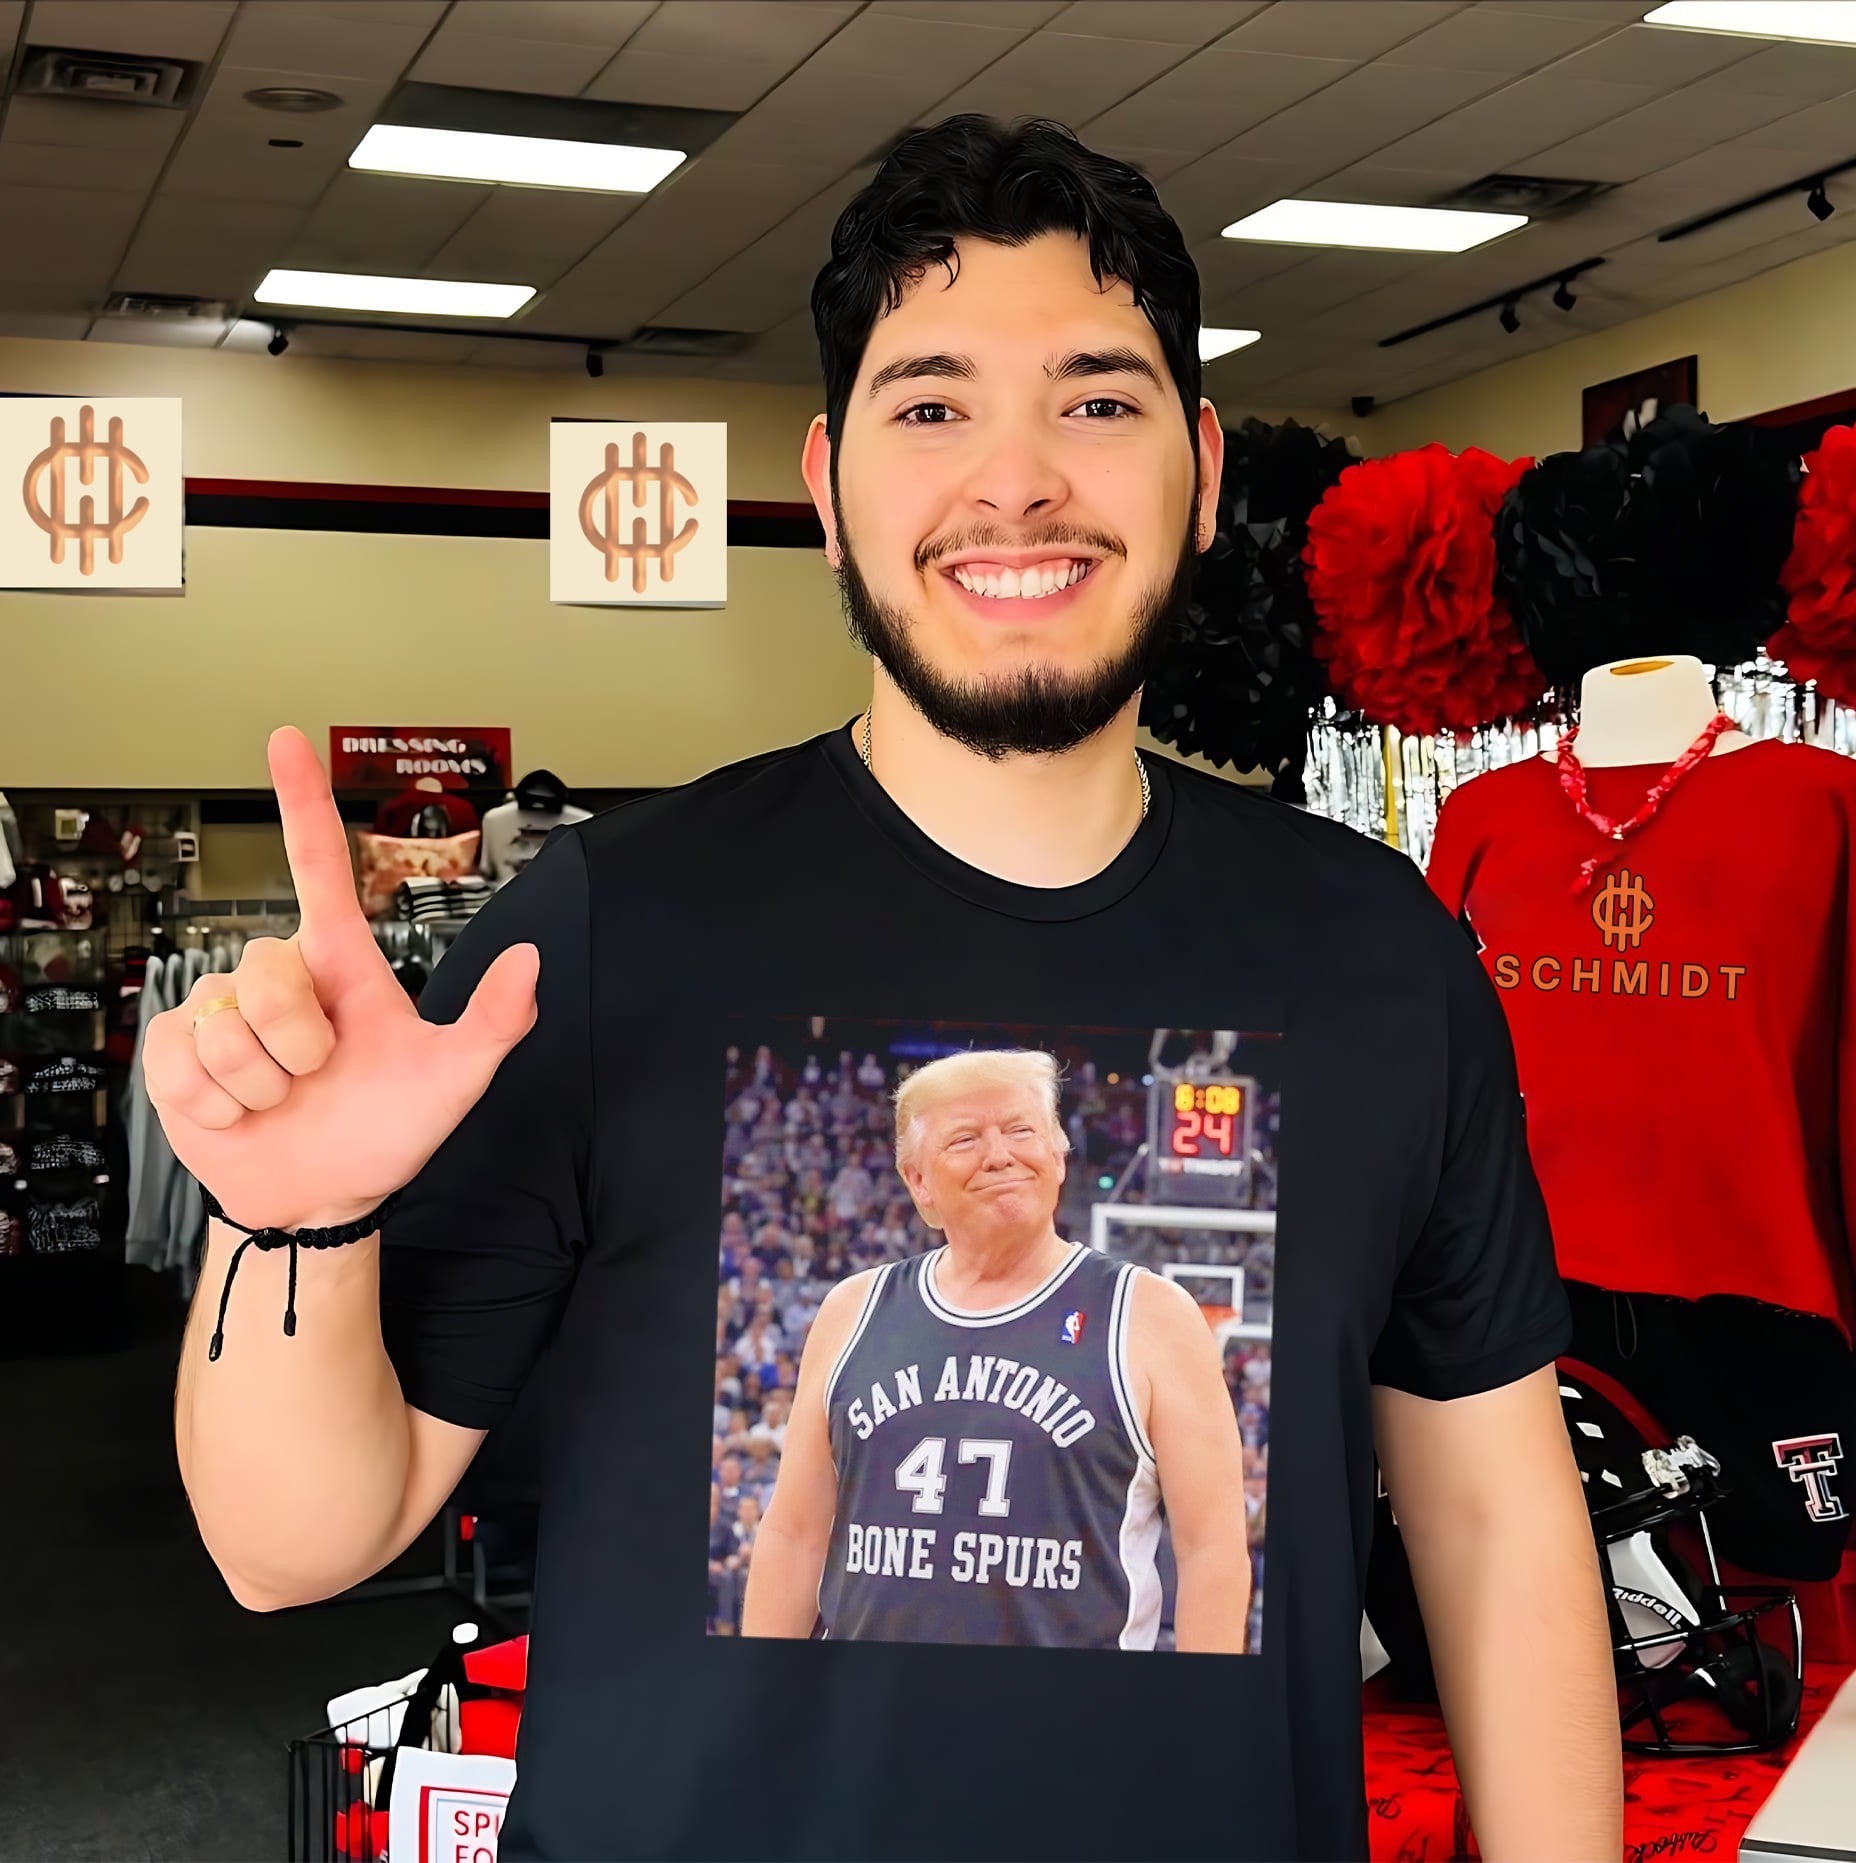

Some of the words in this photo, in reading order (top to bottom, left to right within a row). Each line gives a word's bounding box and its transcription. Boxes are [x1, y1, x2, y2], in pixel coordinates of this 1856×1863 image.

[342, 737, 466, 753] DRESSING
[396, 759, 487, 775] ROOMS
[1494, 954, 1747, 1000] SCHMIDT
[1172, 1111, 1232, 1155] 24
[848, 1364, 923, 1440] SAN
[934, 1355, 1096, 1448] ANTONIO
[895, 1437, 1013, 1517] 47
[846, 1523, 936, 1580] BONE
[951, 1531, 1083, 1591] SPURS
